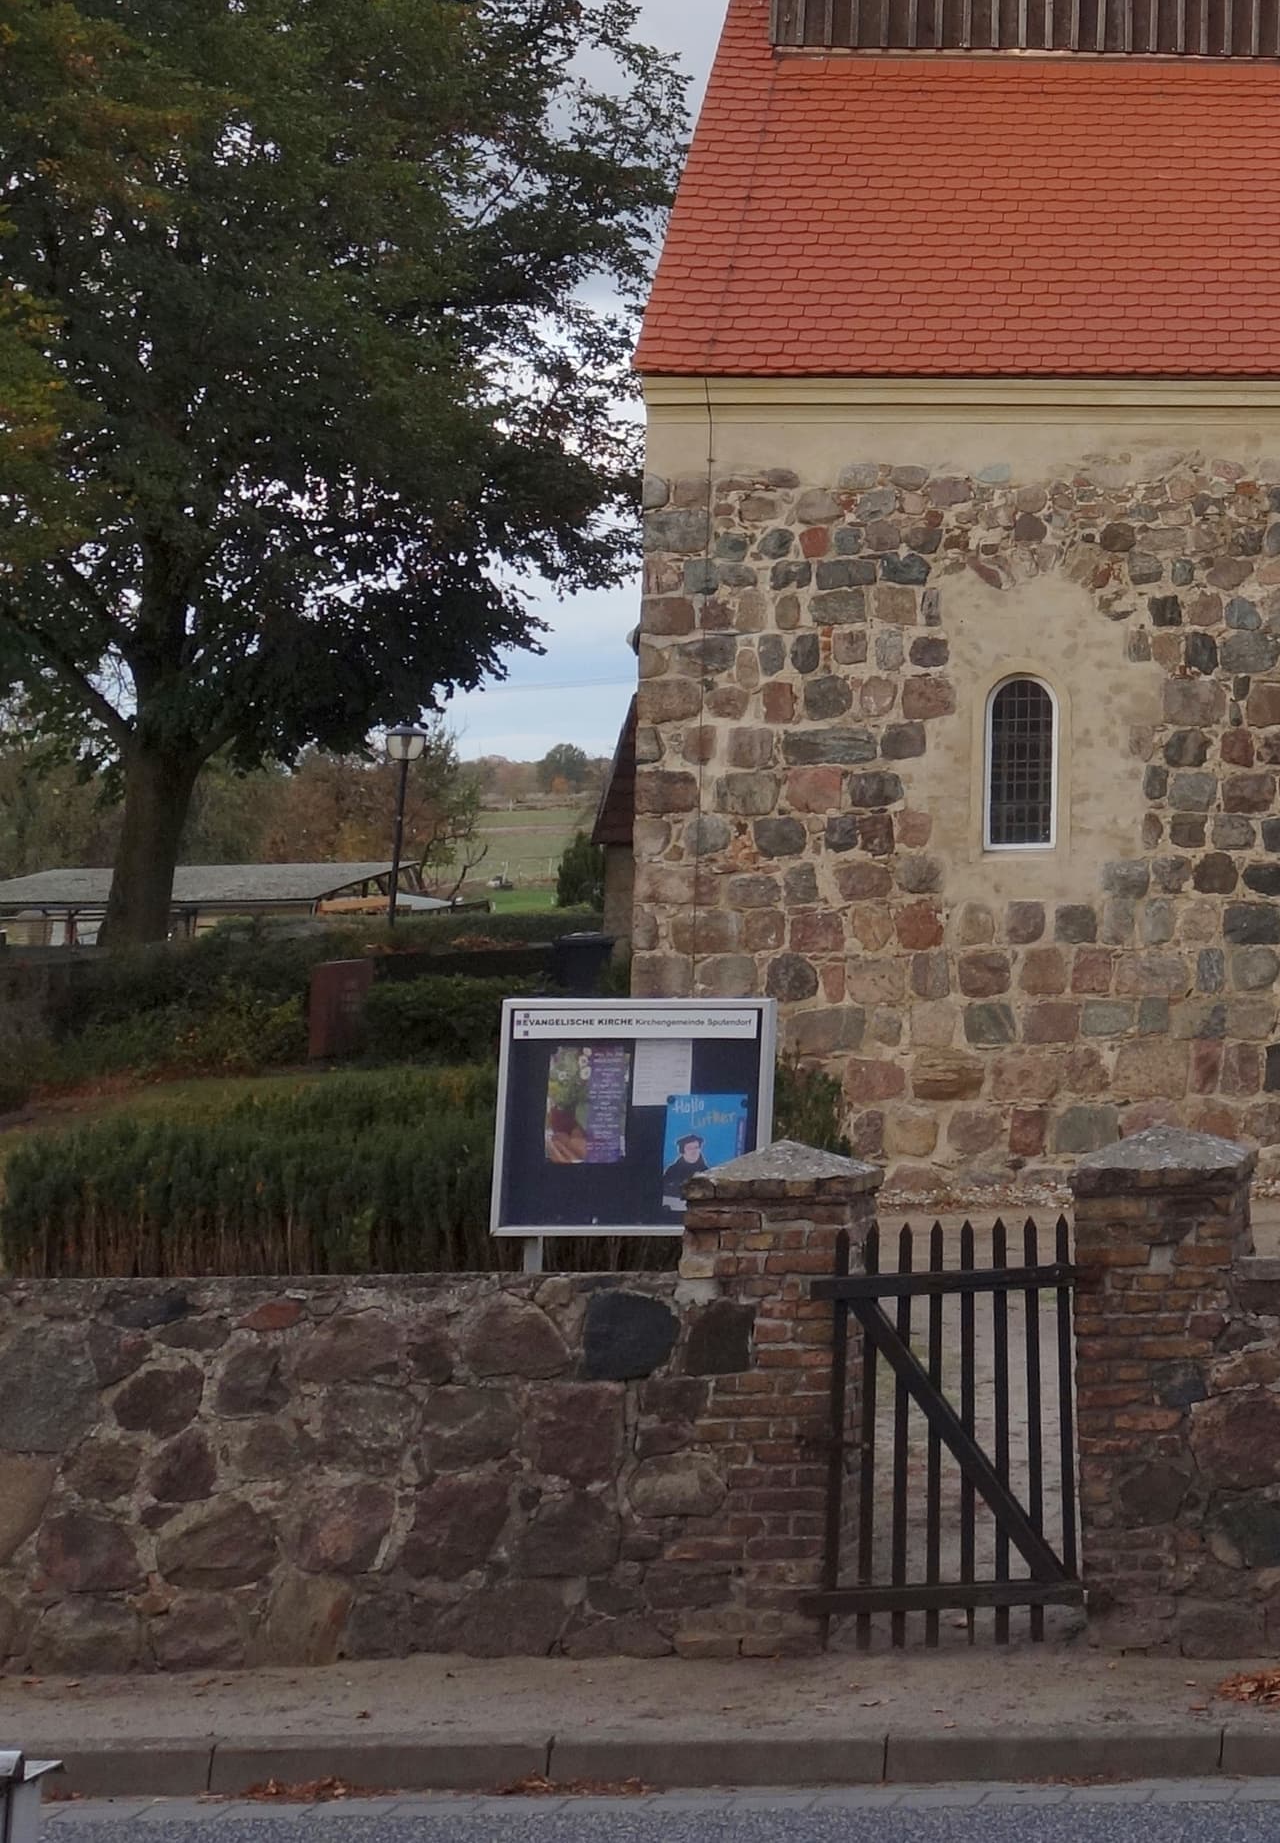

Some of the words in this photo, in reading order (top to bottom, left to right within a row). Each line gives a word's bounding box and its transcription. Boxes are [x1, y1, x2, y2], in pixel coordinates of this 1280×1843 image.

[523, 1018, 594, 1027] EVANGELISCHE
[598, 1018, 633, 1026] KIRCHE
[635, 1018, 705, 1027] Kirchengemeinde
[707, 1018, 752, 1027] Sputendorf
[672, 1098, 705, 1114] Hallo
